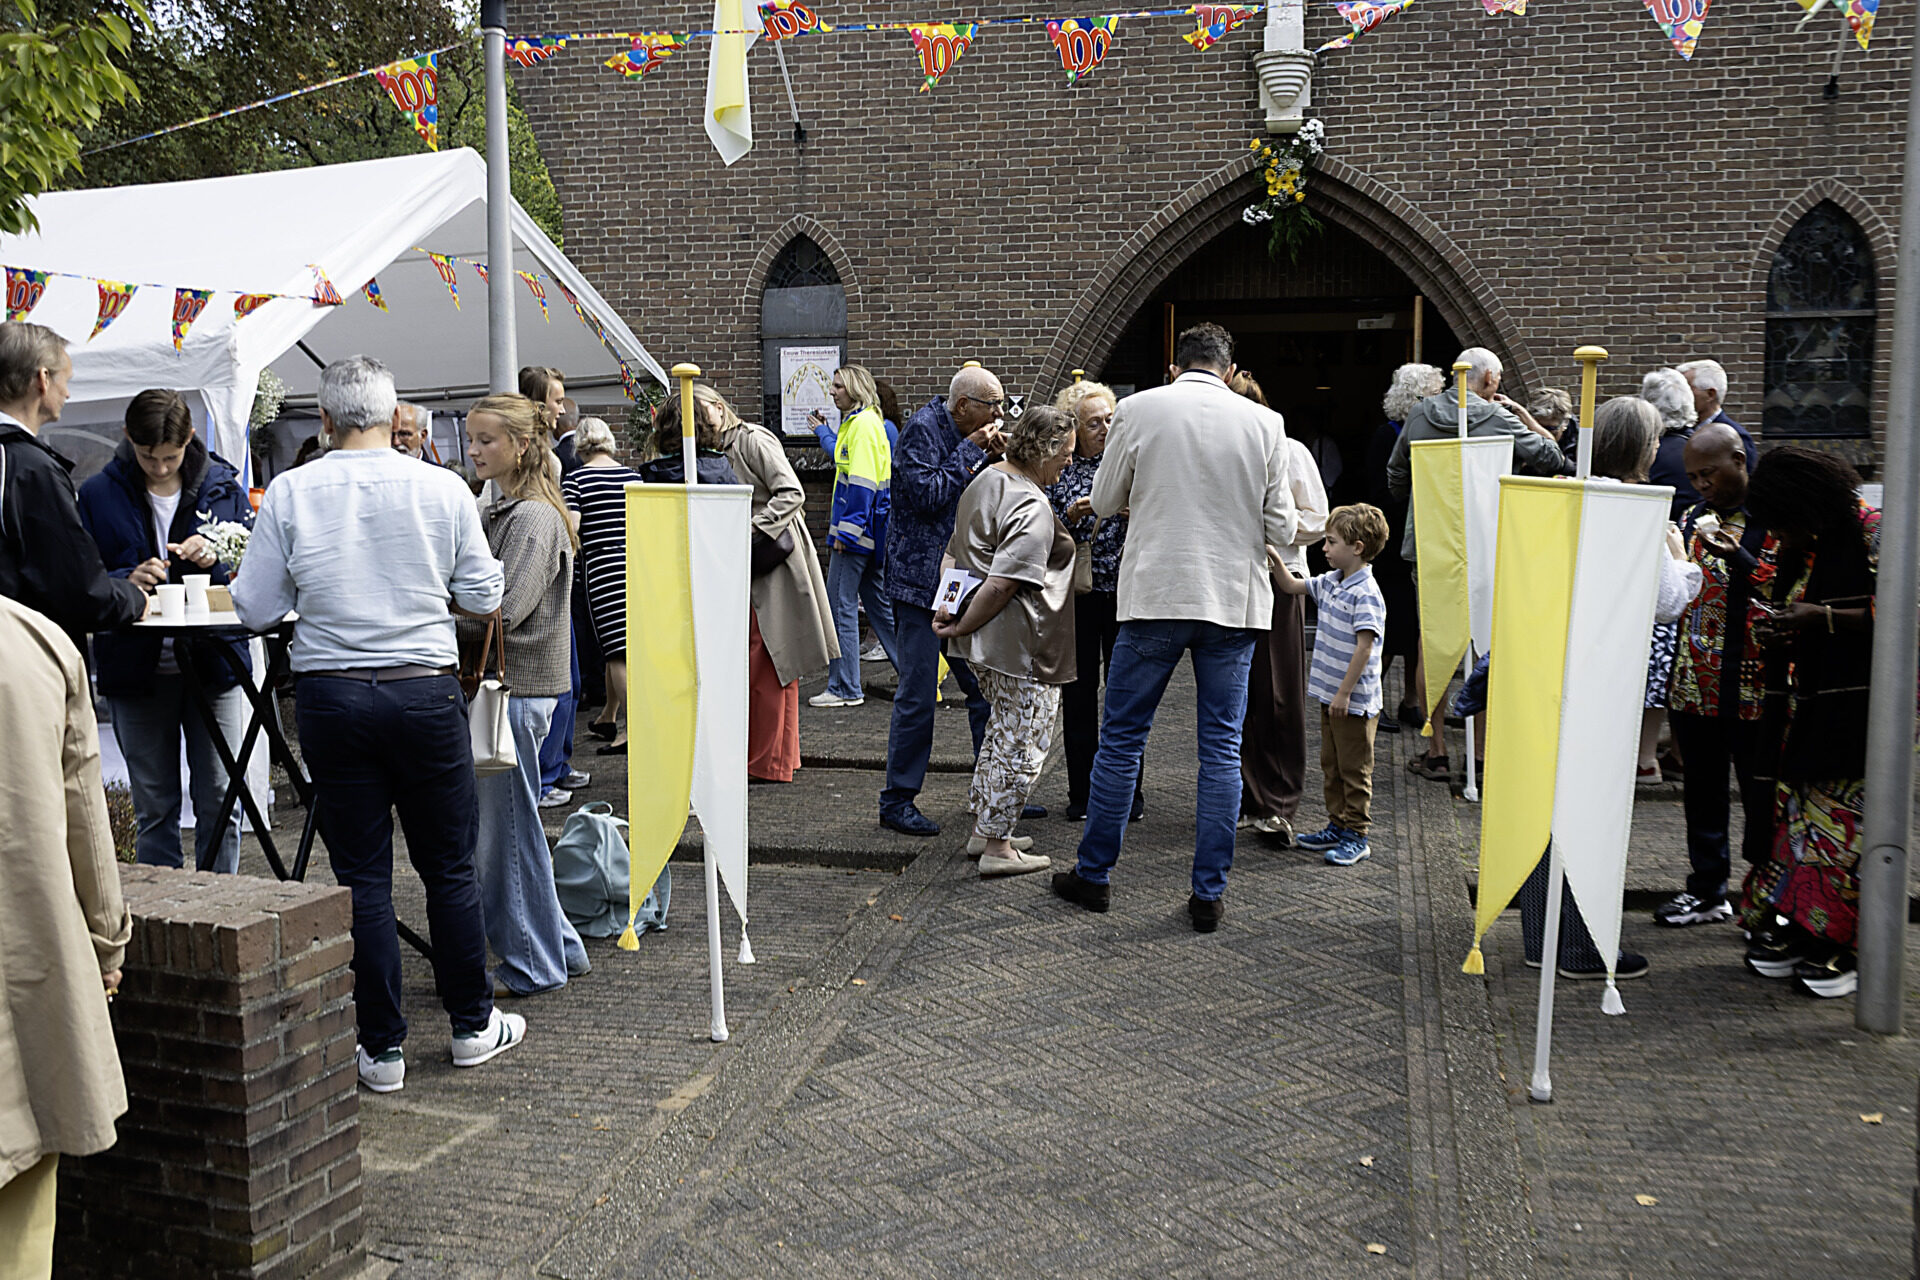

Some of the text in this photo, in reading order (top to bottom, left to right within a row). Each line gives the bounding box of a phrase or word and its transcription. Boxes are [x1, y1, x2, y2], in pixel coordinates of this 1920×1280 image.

[763, 1, 817, 41] 100
[1055, 27, 1112, 73] 100
[386, 66, 437, 112] 100
[6, 279, 44, 312] 100
[98, 291, 131, 319] 100
[172, 297, 206, 323] 100
